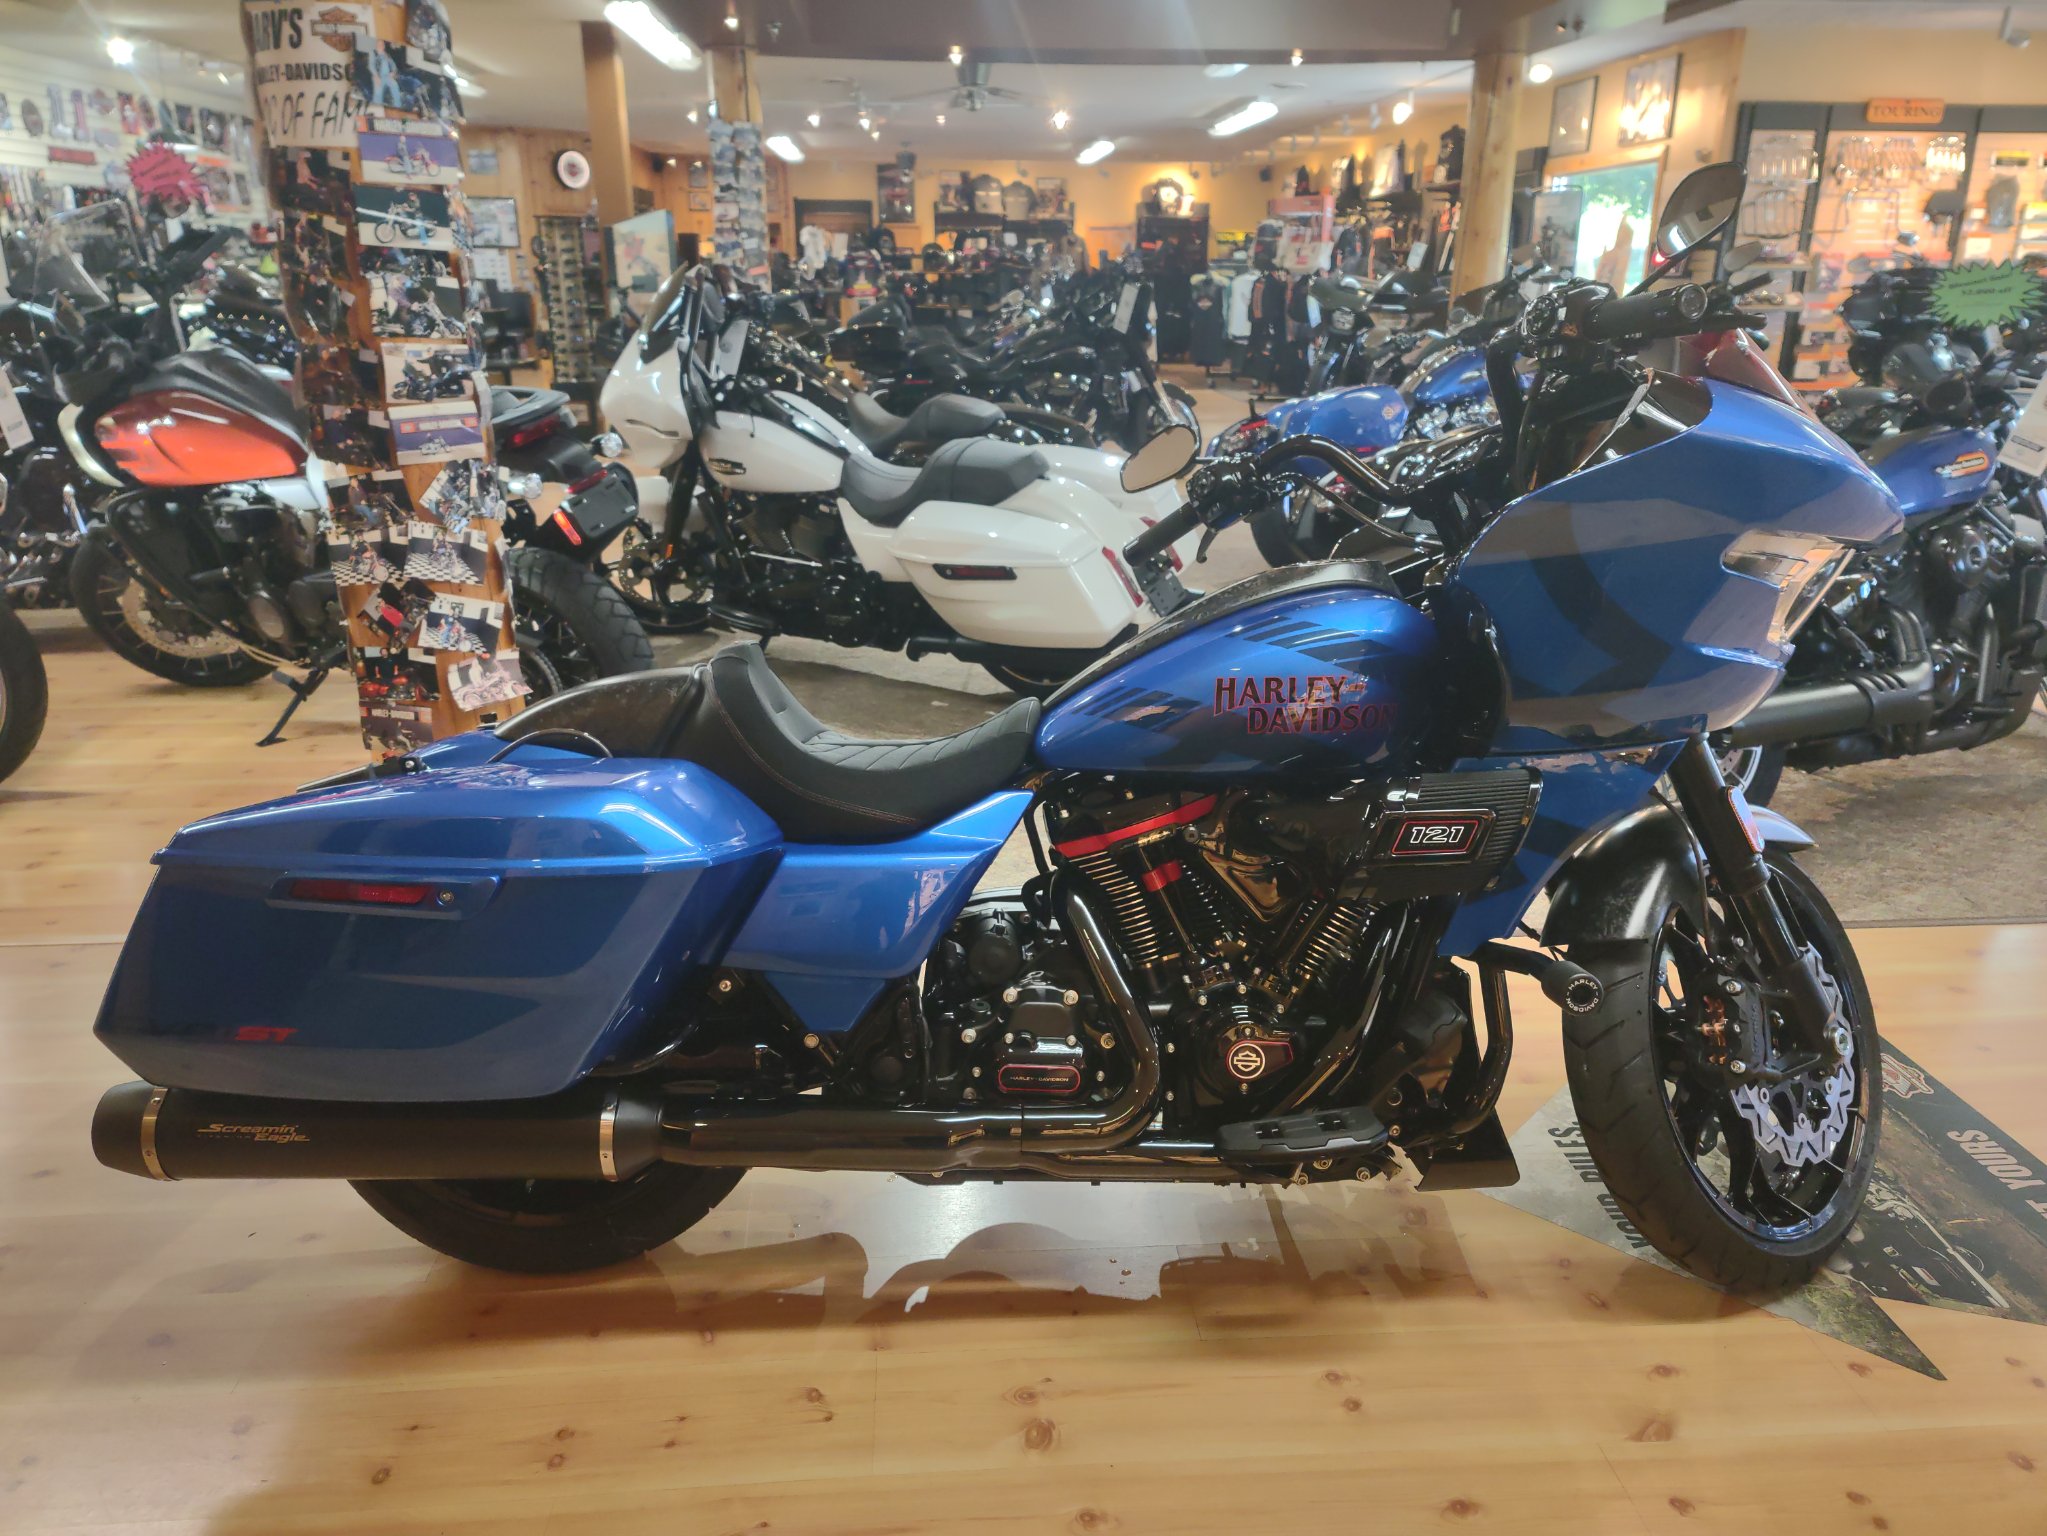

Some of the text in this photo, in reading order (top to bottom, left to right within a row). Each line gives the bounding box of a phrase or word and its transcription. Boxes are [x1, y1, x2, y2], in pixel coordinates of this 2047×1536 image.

[1873, 106, 1942, 117] TOURING
[1213, 675, 1347, 718] HARLEY
[1247, 703, 1398, 735] DAVIDSON
[1410, 827, 1465, 844] 121
[254, 1132, 310, 1144] Eagle
[1946, 1129, 2047, 1191] YOURS
